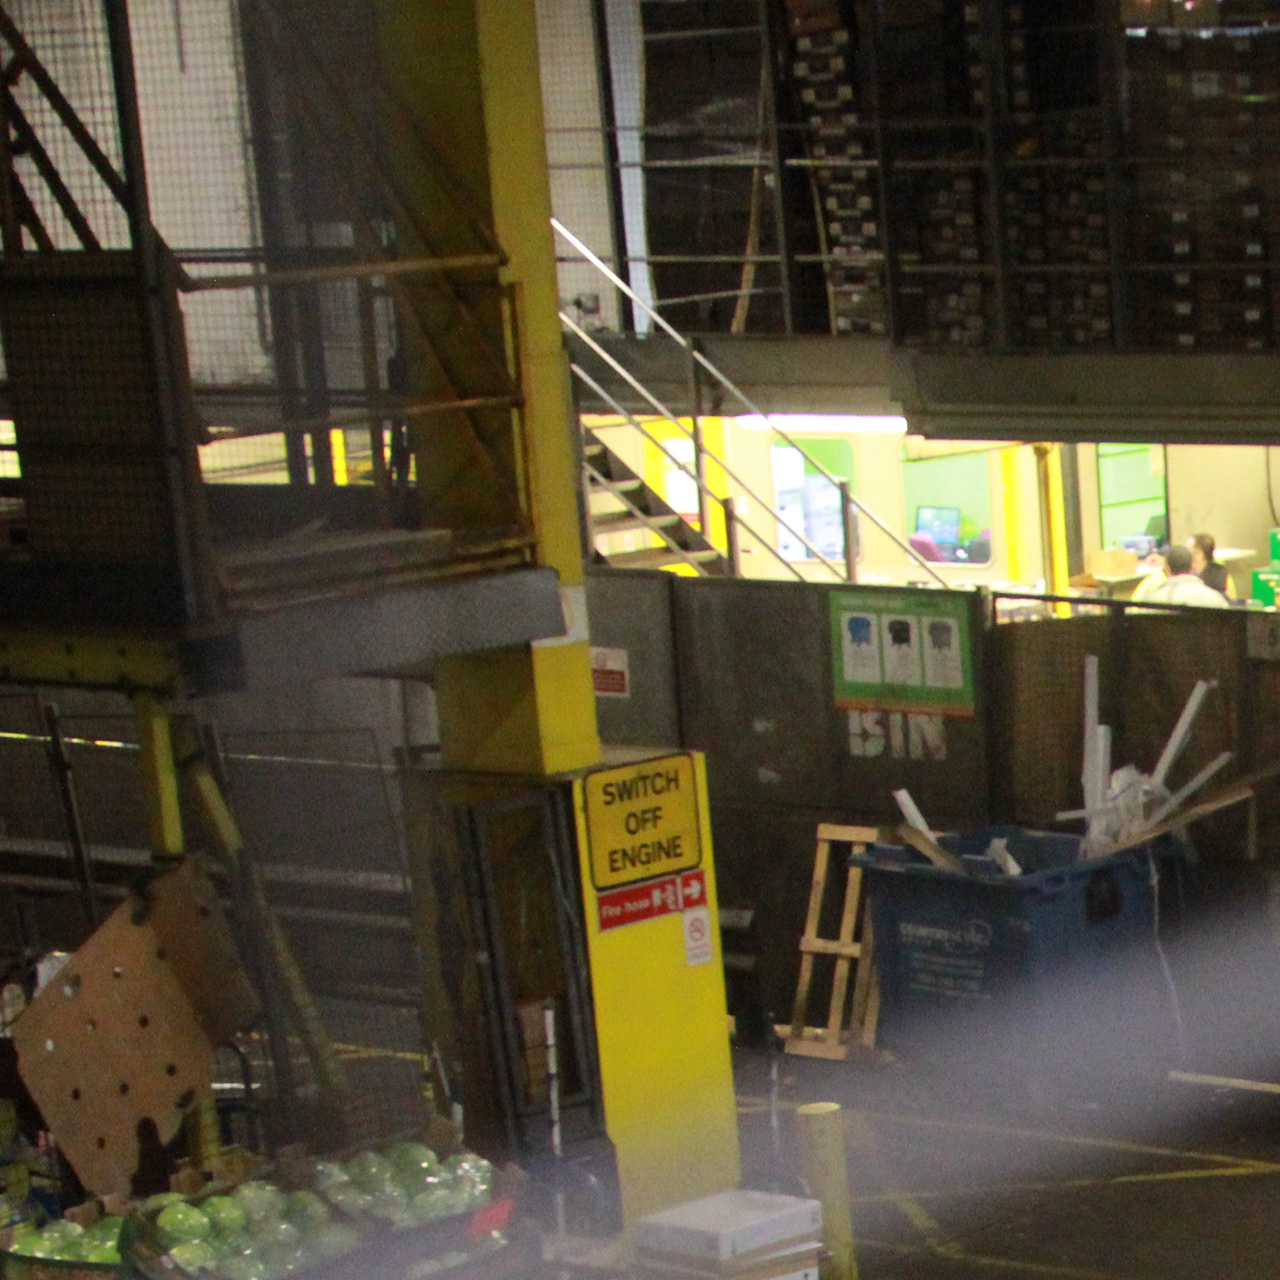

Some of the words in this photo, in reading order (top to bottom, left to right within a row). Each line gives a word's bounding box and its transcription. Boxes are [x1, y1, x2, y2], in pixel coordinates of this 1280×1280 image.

[602, 769, 680, 805] SWITCH
[624, 806, 662, 834] OFF
[608, 836, 683, 873] ENGINE
